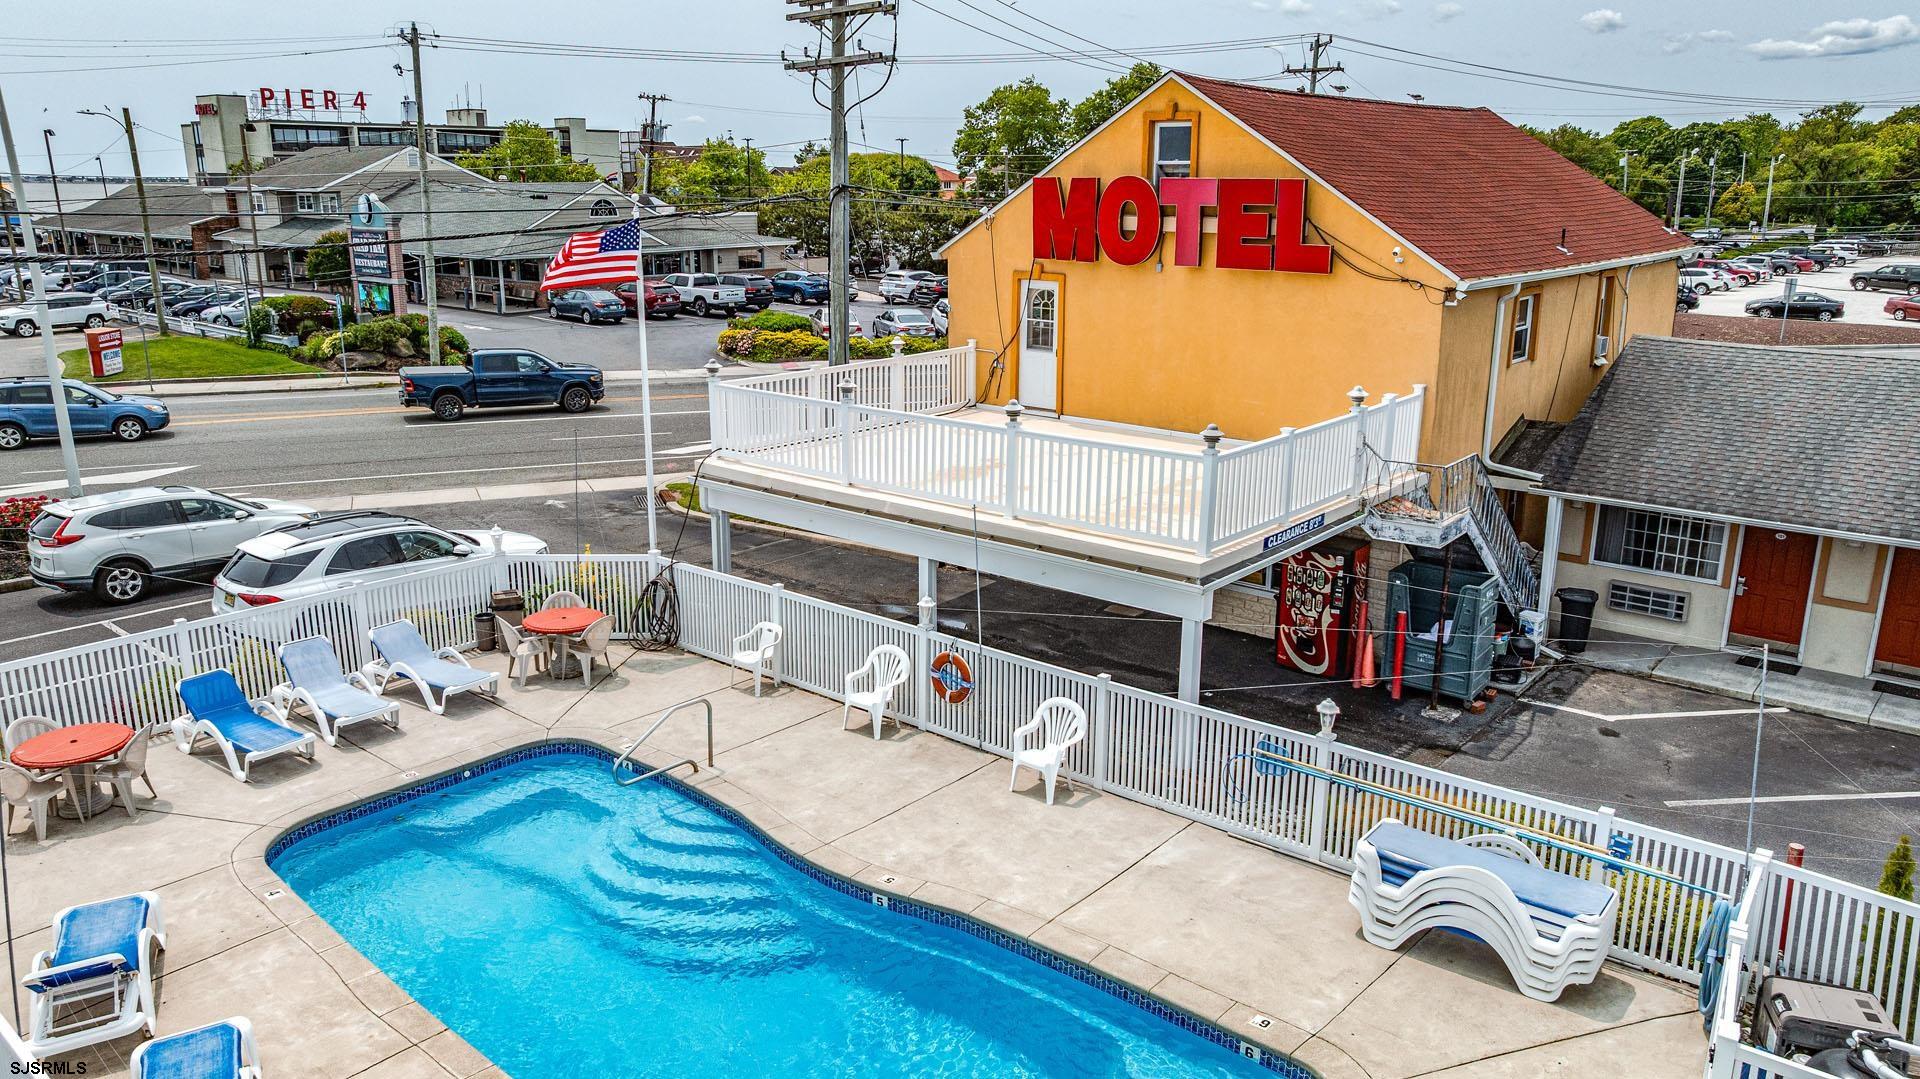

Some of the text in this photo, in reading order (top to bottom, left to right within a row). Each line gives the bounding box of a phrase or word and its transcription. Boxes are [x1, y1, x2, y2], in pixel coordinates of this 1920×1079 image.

[260, 88, 367, 110] PIER 4
[1032, 175, 1334, 274] MOTEL
[1268, 522, 1308, 547] CLEARANCE
[876, 897, 884, 907] 5
[1245, 1046, 1254, 1059] 6
